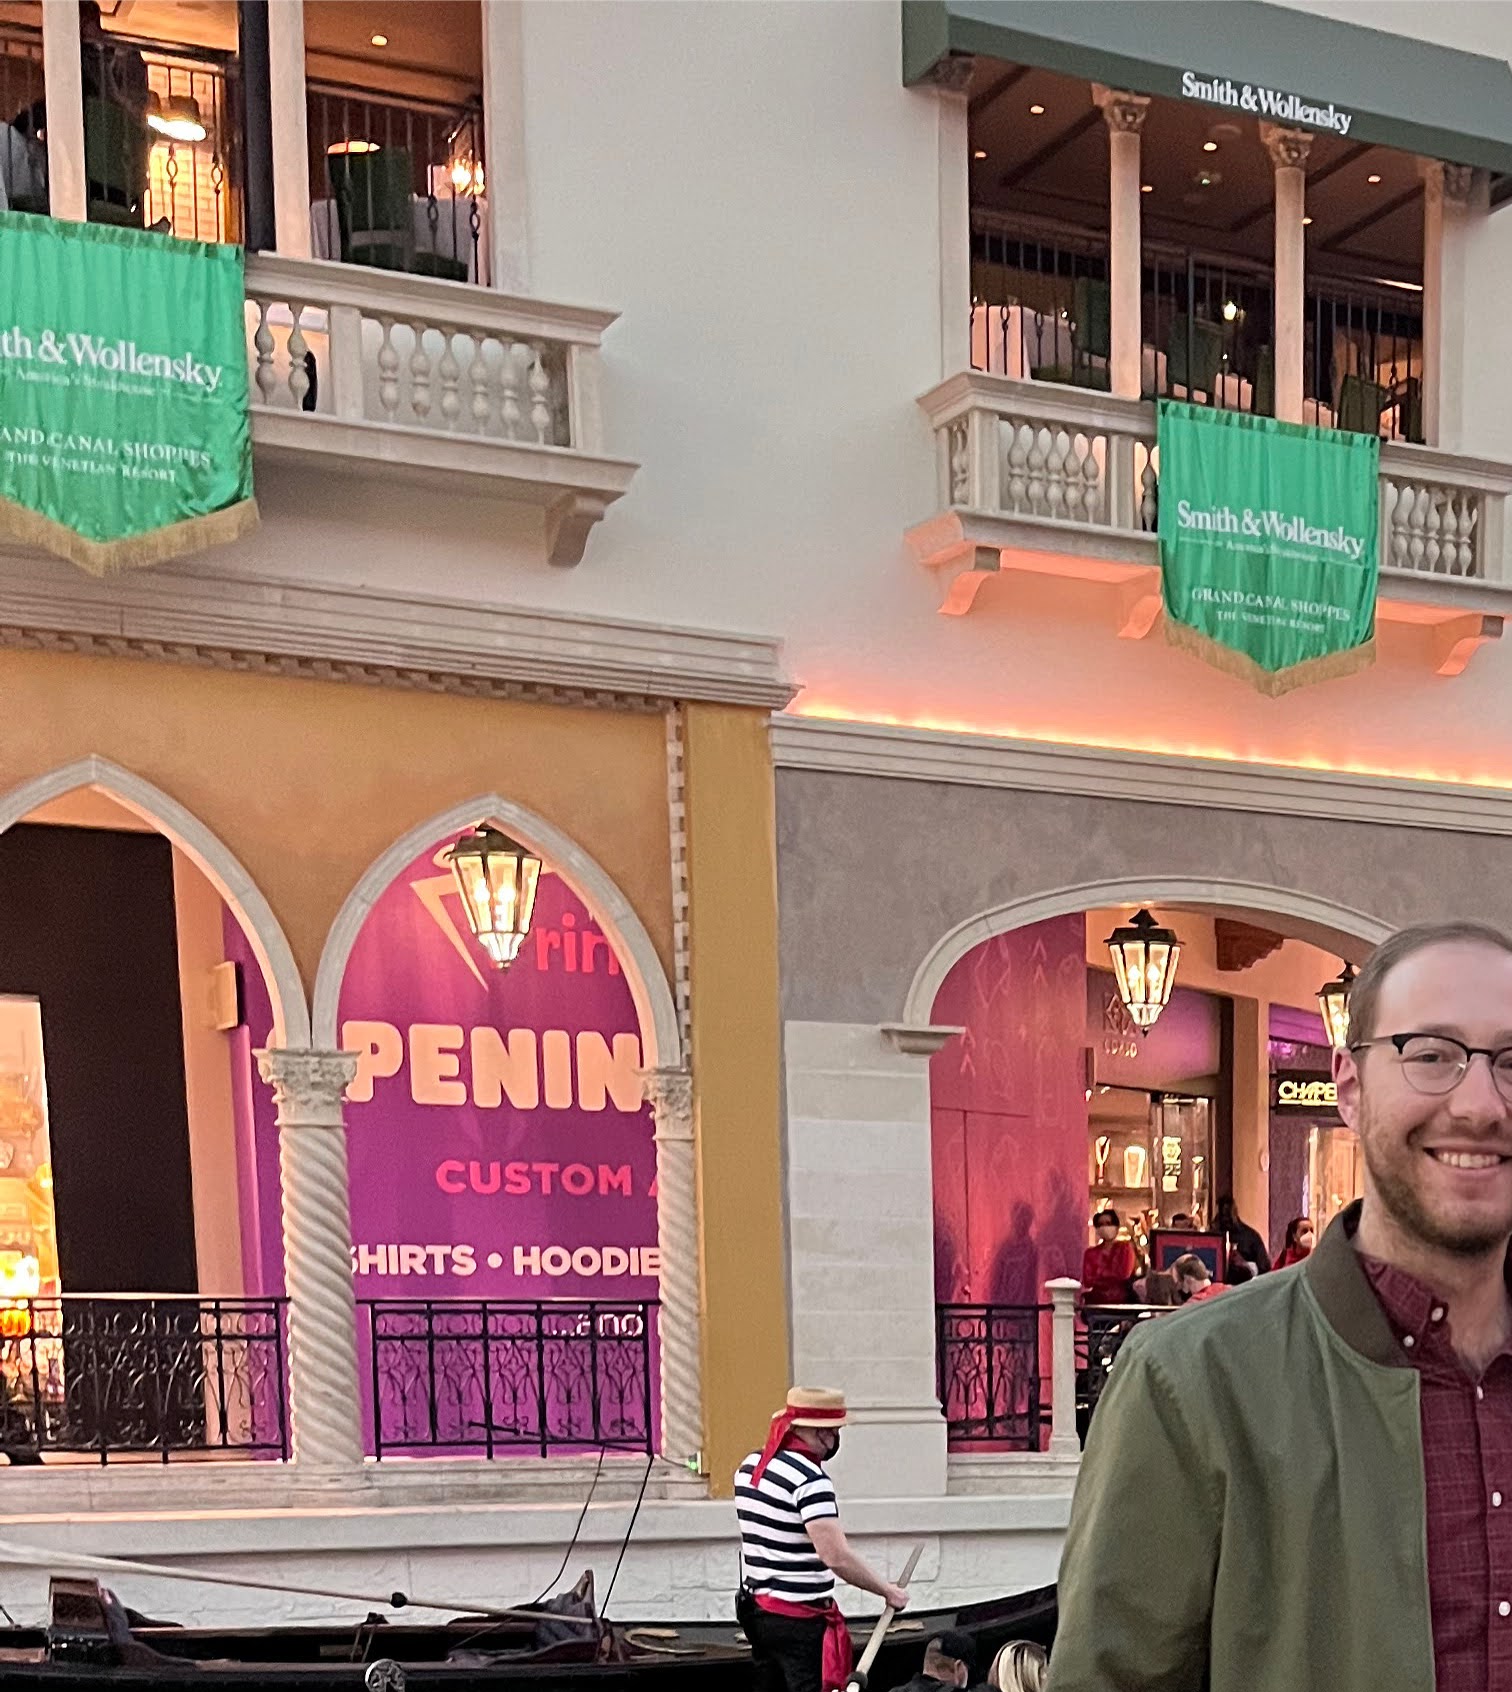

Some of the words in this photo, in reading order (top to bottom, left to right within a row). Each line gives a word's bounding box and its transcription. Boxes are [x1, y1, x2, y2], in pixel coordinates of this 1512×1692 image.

[1182, 71, 1239, 107] Smith
[1240, 84, 1258, 112] &
[1257, 87, 1352, 135] Wollensky
[0, 326, 33, 360] th
[38, 329, 67, 365] &
[66, 333, 224, 392] Wollensky
[0, 427, 45, 445] AND
[47, 431, 117, 455] CANAL
[123, 441, 211, 469] SHOPPES
[9, 452, 39, 465] THE
[1178, 499, 1239, 533] Smith
[1241, 508, 1261, 537] &
[1260, 510, 1365, 560] Wollensky
[1191, 587, 1245, 605] GRAND
[1243, 592, 1288, 610] CANAL
[341, 1020, 642, 1113] PENIN
[1278, 1080, 1338, 1102] CHAPE
[435, 1159, 633, 1197] CUSTOM
[512, 1245, 661, 1277] HOODIE
